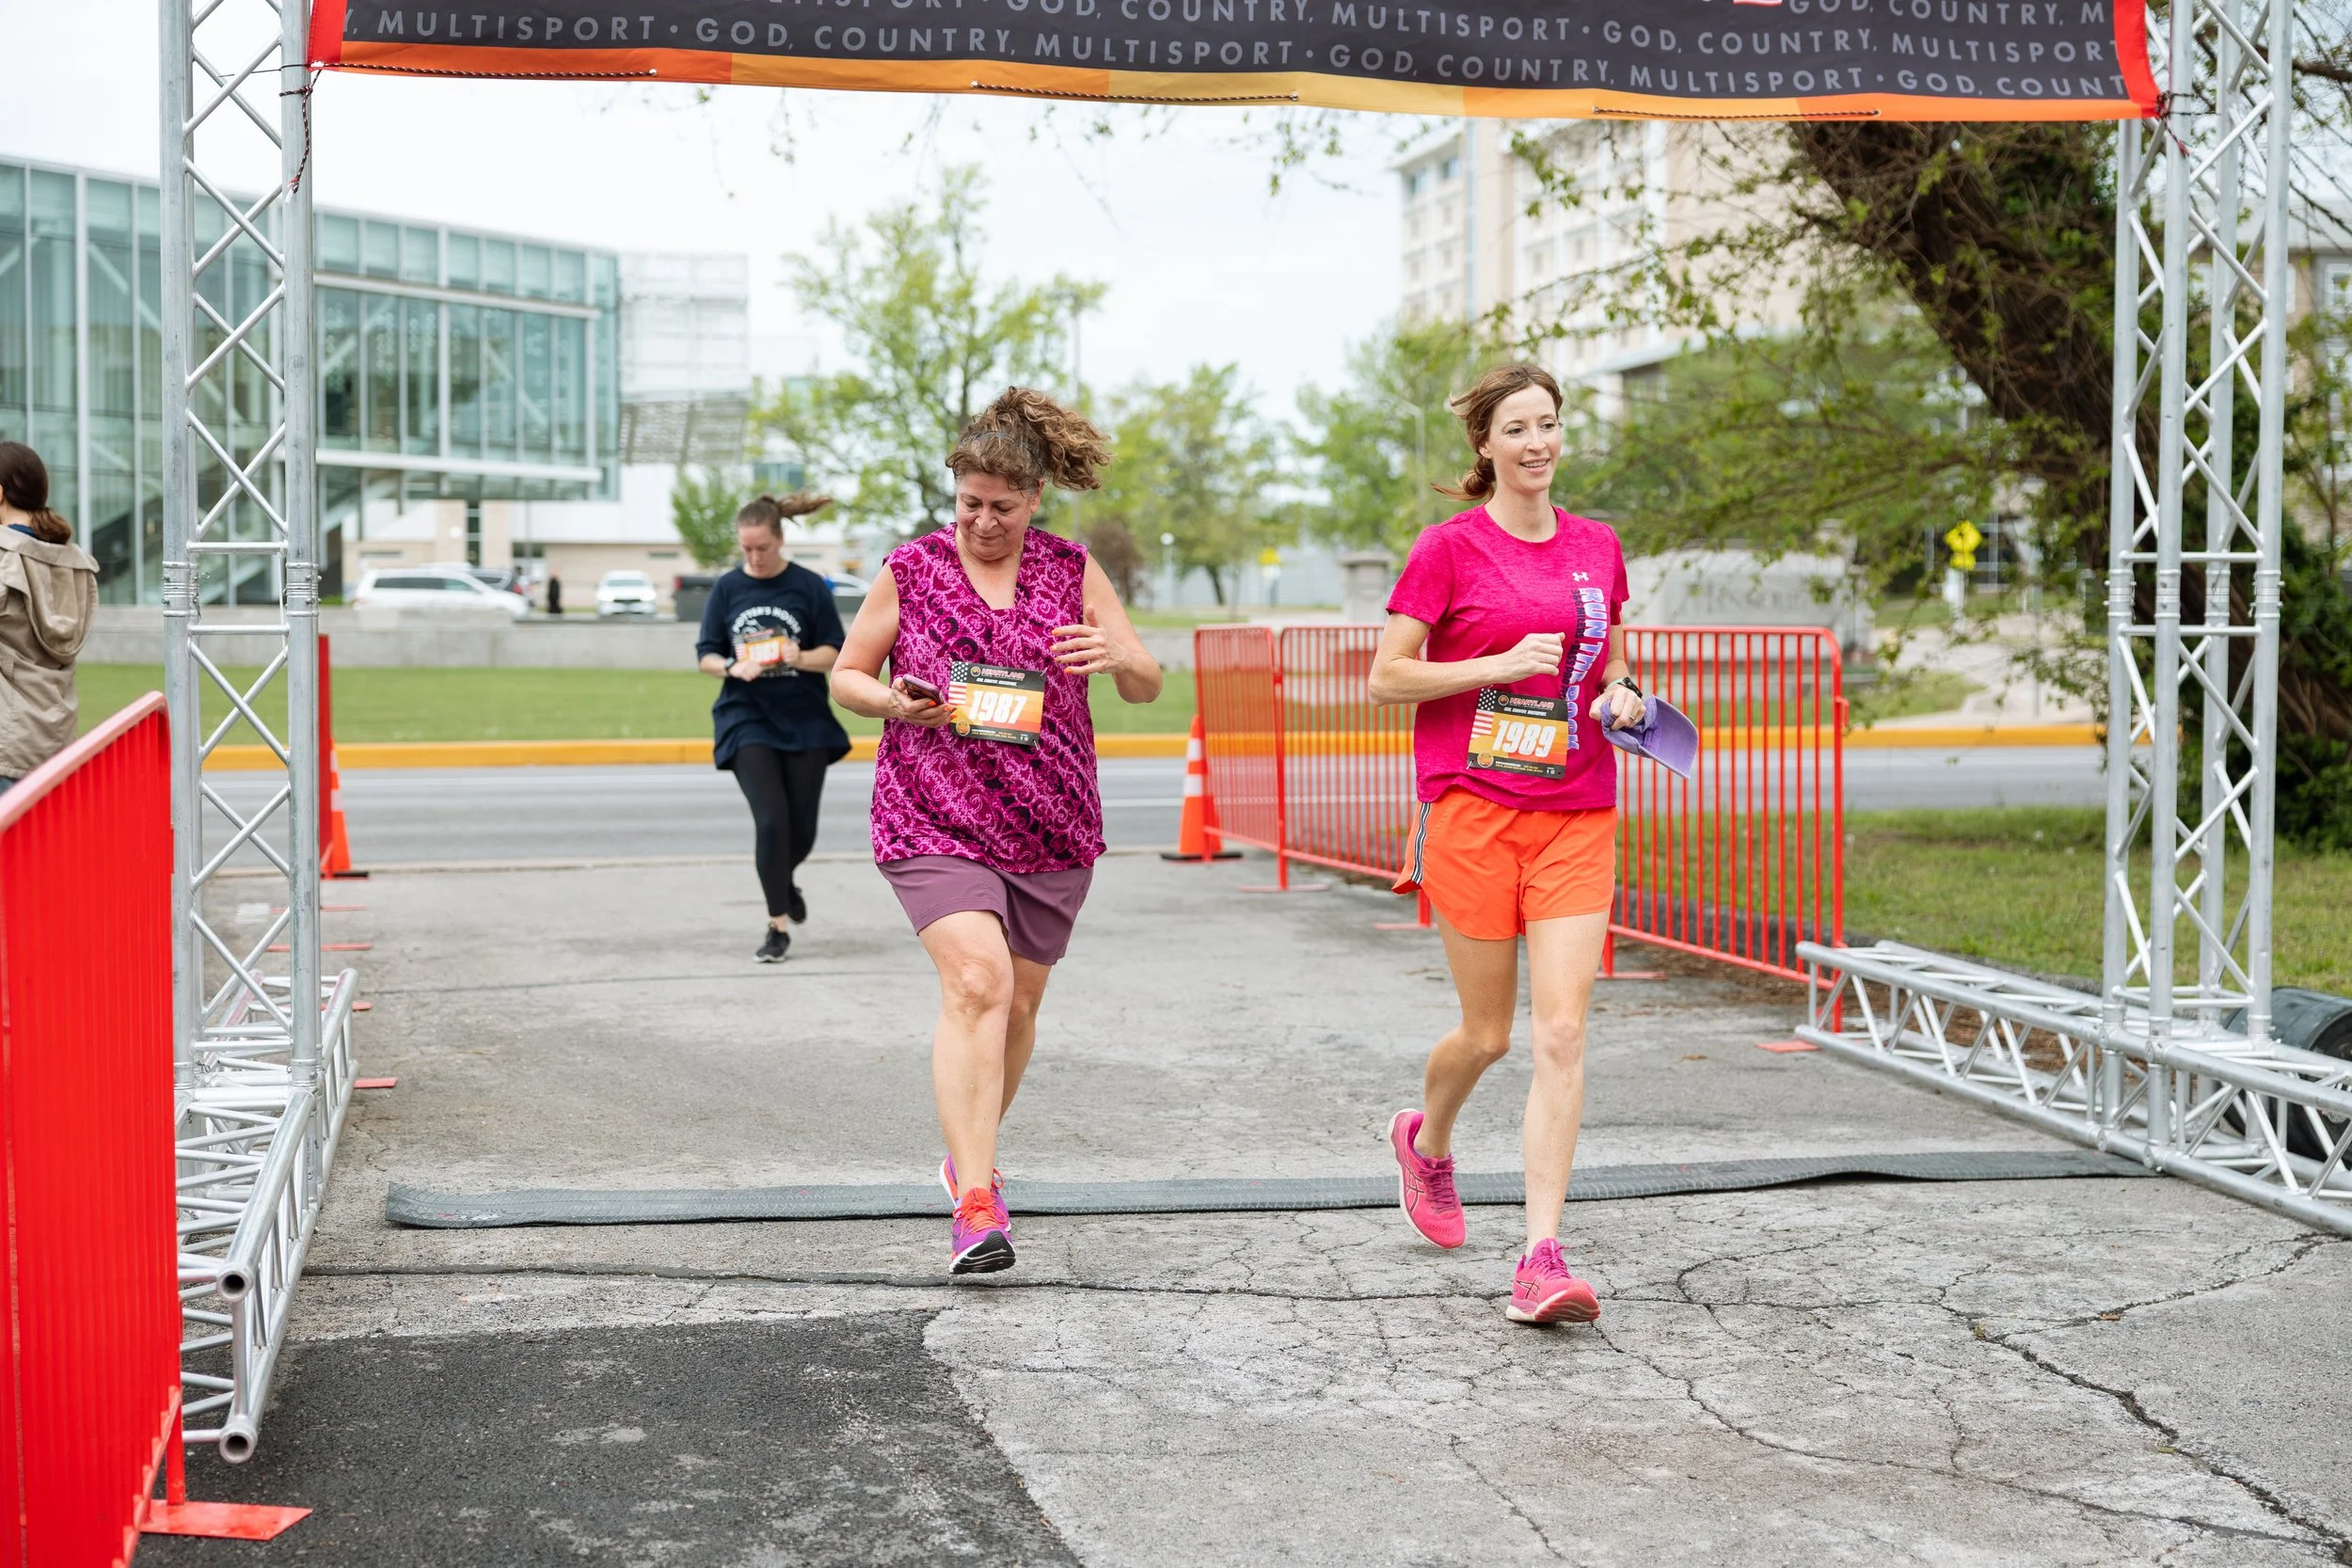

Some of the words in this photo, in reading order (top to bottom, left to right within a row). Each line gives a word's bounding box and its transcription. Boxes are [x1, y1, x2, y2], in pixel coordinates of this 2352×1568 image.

[1121, 0, 1313, 23] COUNTRY,
[1332, 2, 1569, 40] MULTISPORT
[1603, 21, 1682, 54] GOD,
[1698, 28, 1877, 55] COUNTRY,
[1892, 33, 2118, 62] MULTISPOR
[1889, 0, 2063, 25] COUNTRY,
[376, 10, 655, 40] MULTISPORT
[696, 18, 793, 50] GOD,
[815, 25, 1015, 55] COUNTRY,
[1035, 33, 1292, 65] MULTISPORT
[1329, 44, 1418, 76] GOD,
[1437, 54, 1614, 85] COUNTRY,
[1630, 65, 1862, 92] MULTISPORT
[1898, 70, 1982, 95] GOD,
[1996, 74, 2125, 96] COUNT
[1578, 588, 1607, 639] RUN
[1569, 641, 1603, 685] THE
[967, 689, 1027, 724] 1987
[1492, 720, 1556, 758] 1989
